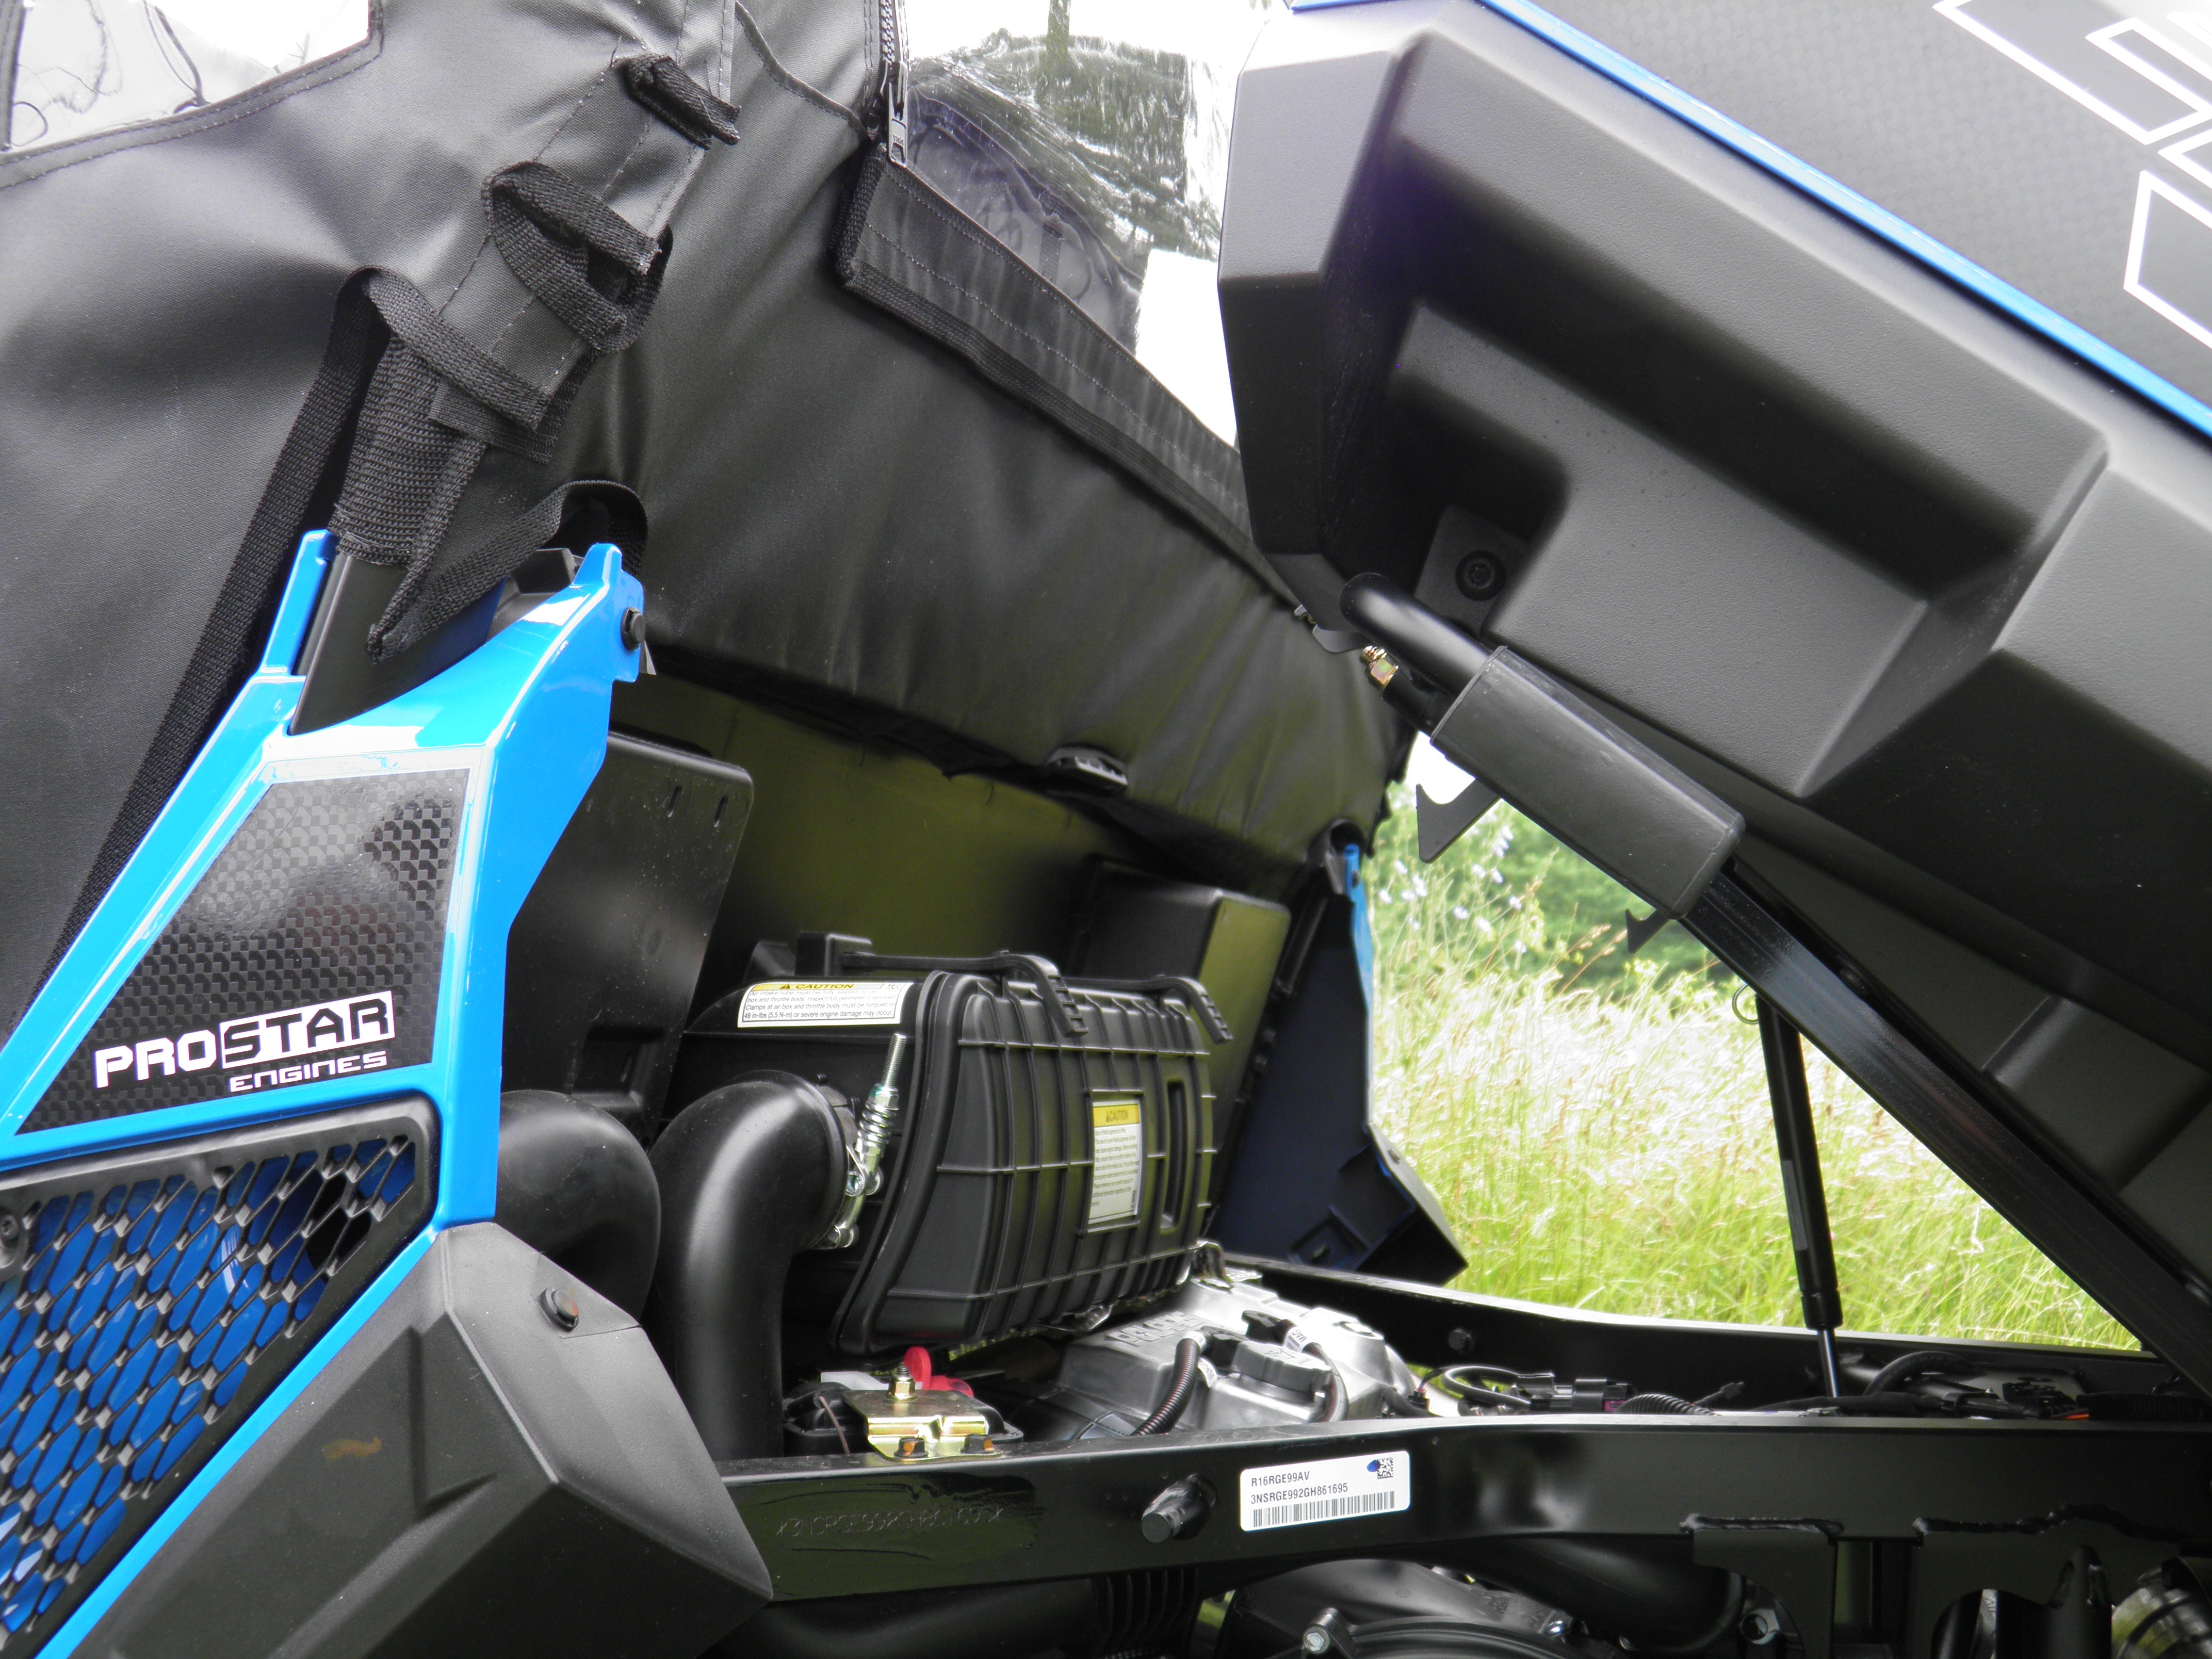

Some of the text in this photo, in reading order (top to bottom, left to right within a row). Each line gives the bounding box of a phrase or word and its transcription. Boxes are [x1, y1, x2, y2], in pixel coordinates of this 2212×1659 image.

[779, 1011, 793, 1019] N-m)
[820, 1011, 838, 1019] engine
[95, 994, 393, 1088] PROSTAR
[230, 1050, 387, 1093] ENGINES
[1109, 1109, 1129, 1122] CAUTION
[1251, 1471, 1310, 1487] R16RGE99AV
[1250, 1482, 1348, 1505] 3NSRGE992GH861695
